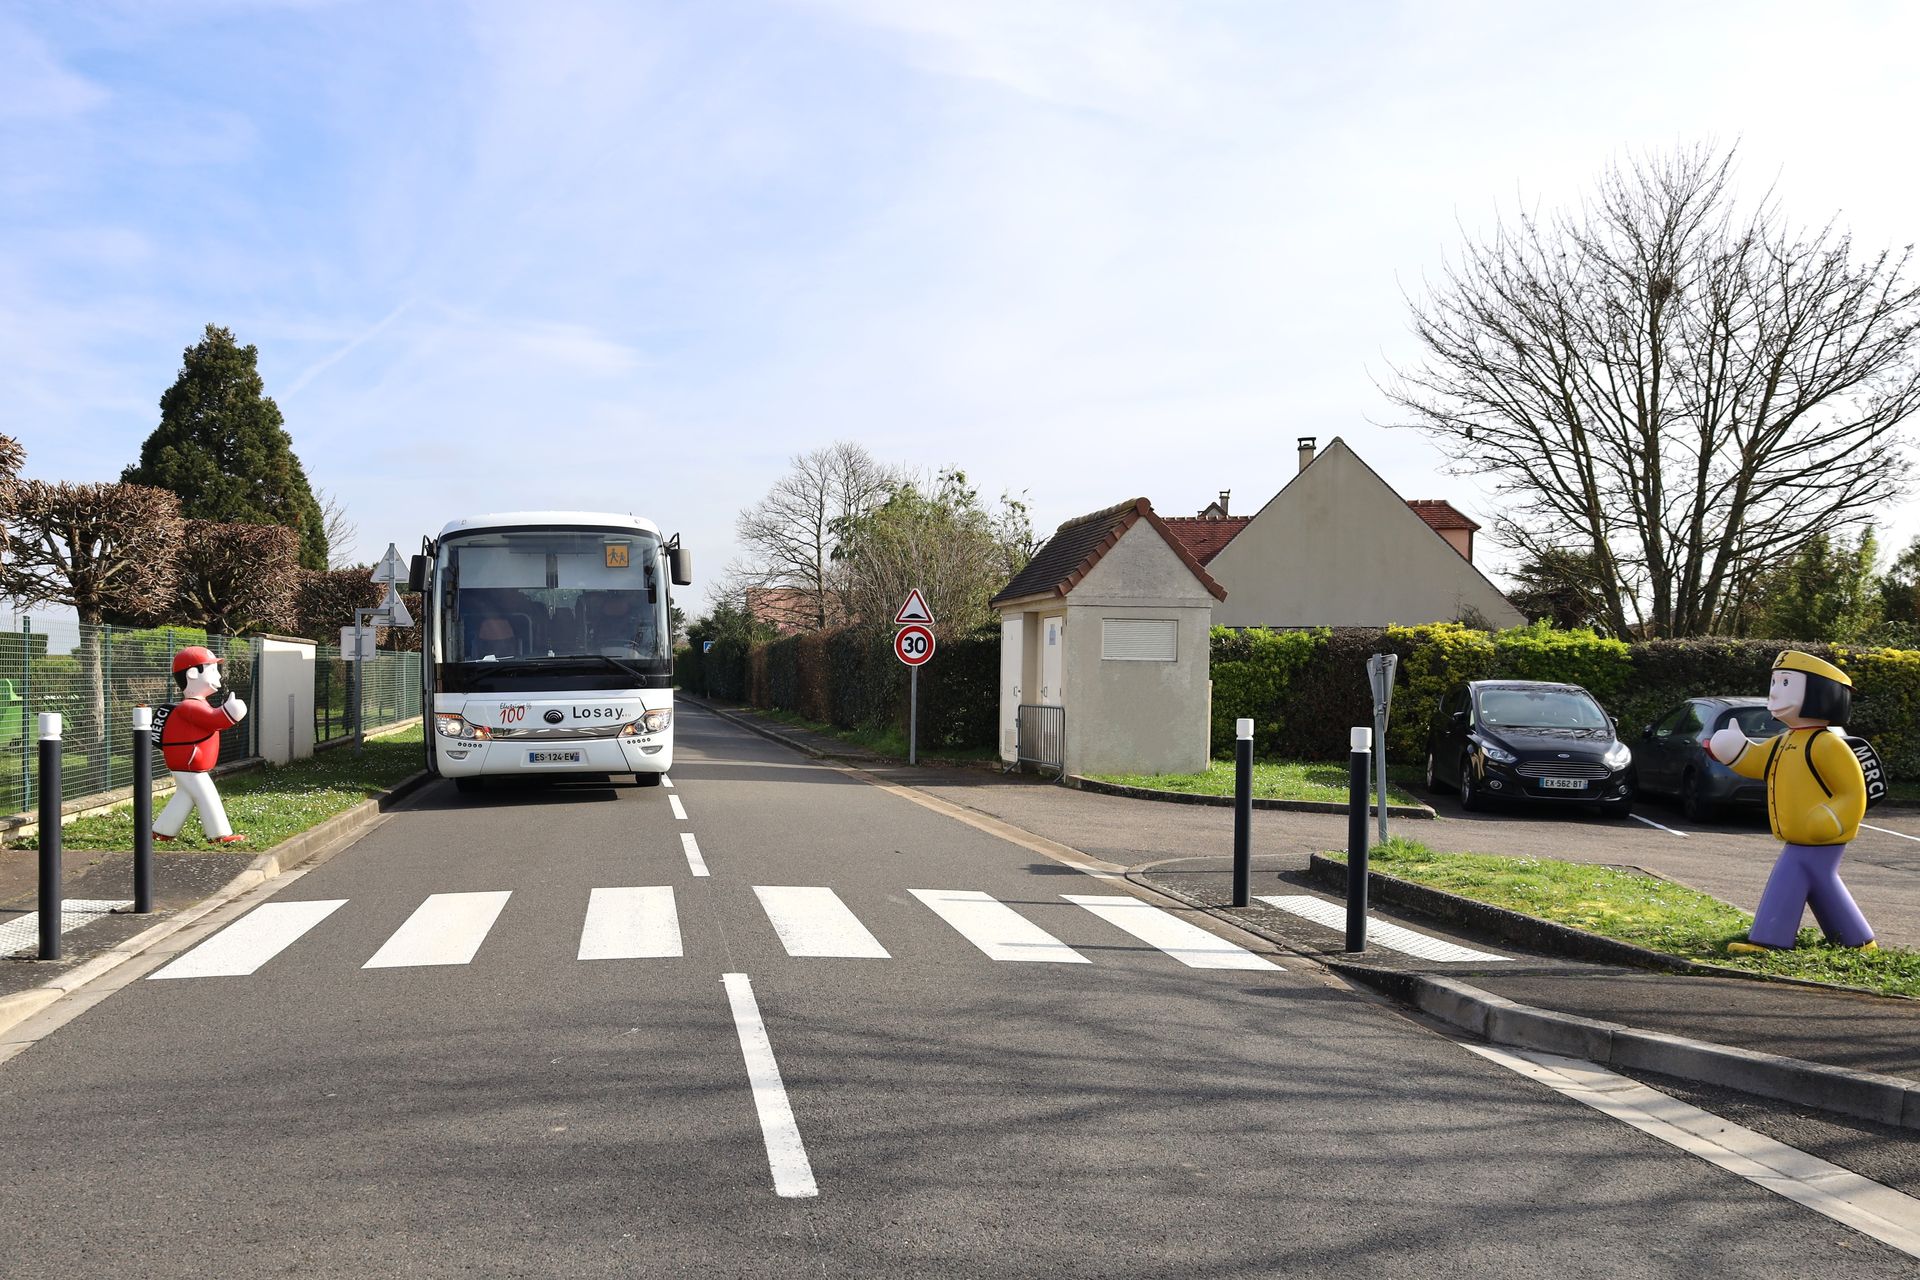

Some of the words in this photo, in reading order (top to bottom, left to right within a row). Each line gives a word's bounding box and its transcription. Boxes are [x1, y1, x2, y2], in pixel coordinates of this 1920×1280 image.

[903, 636, 927, 654] 30
[500, 705, 525, 724] 100
[151, 707, 170, 743] MERCI
[1853, 745, 1884, 799] MERCI
[1545, 779, 1582, 788] EX-562-BT
